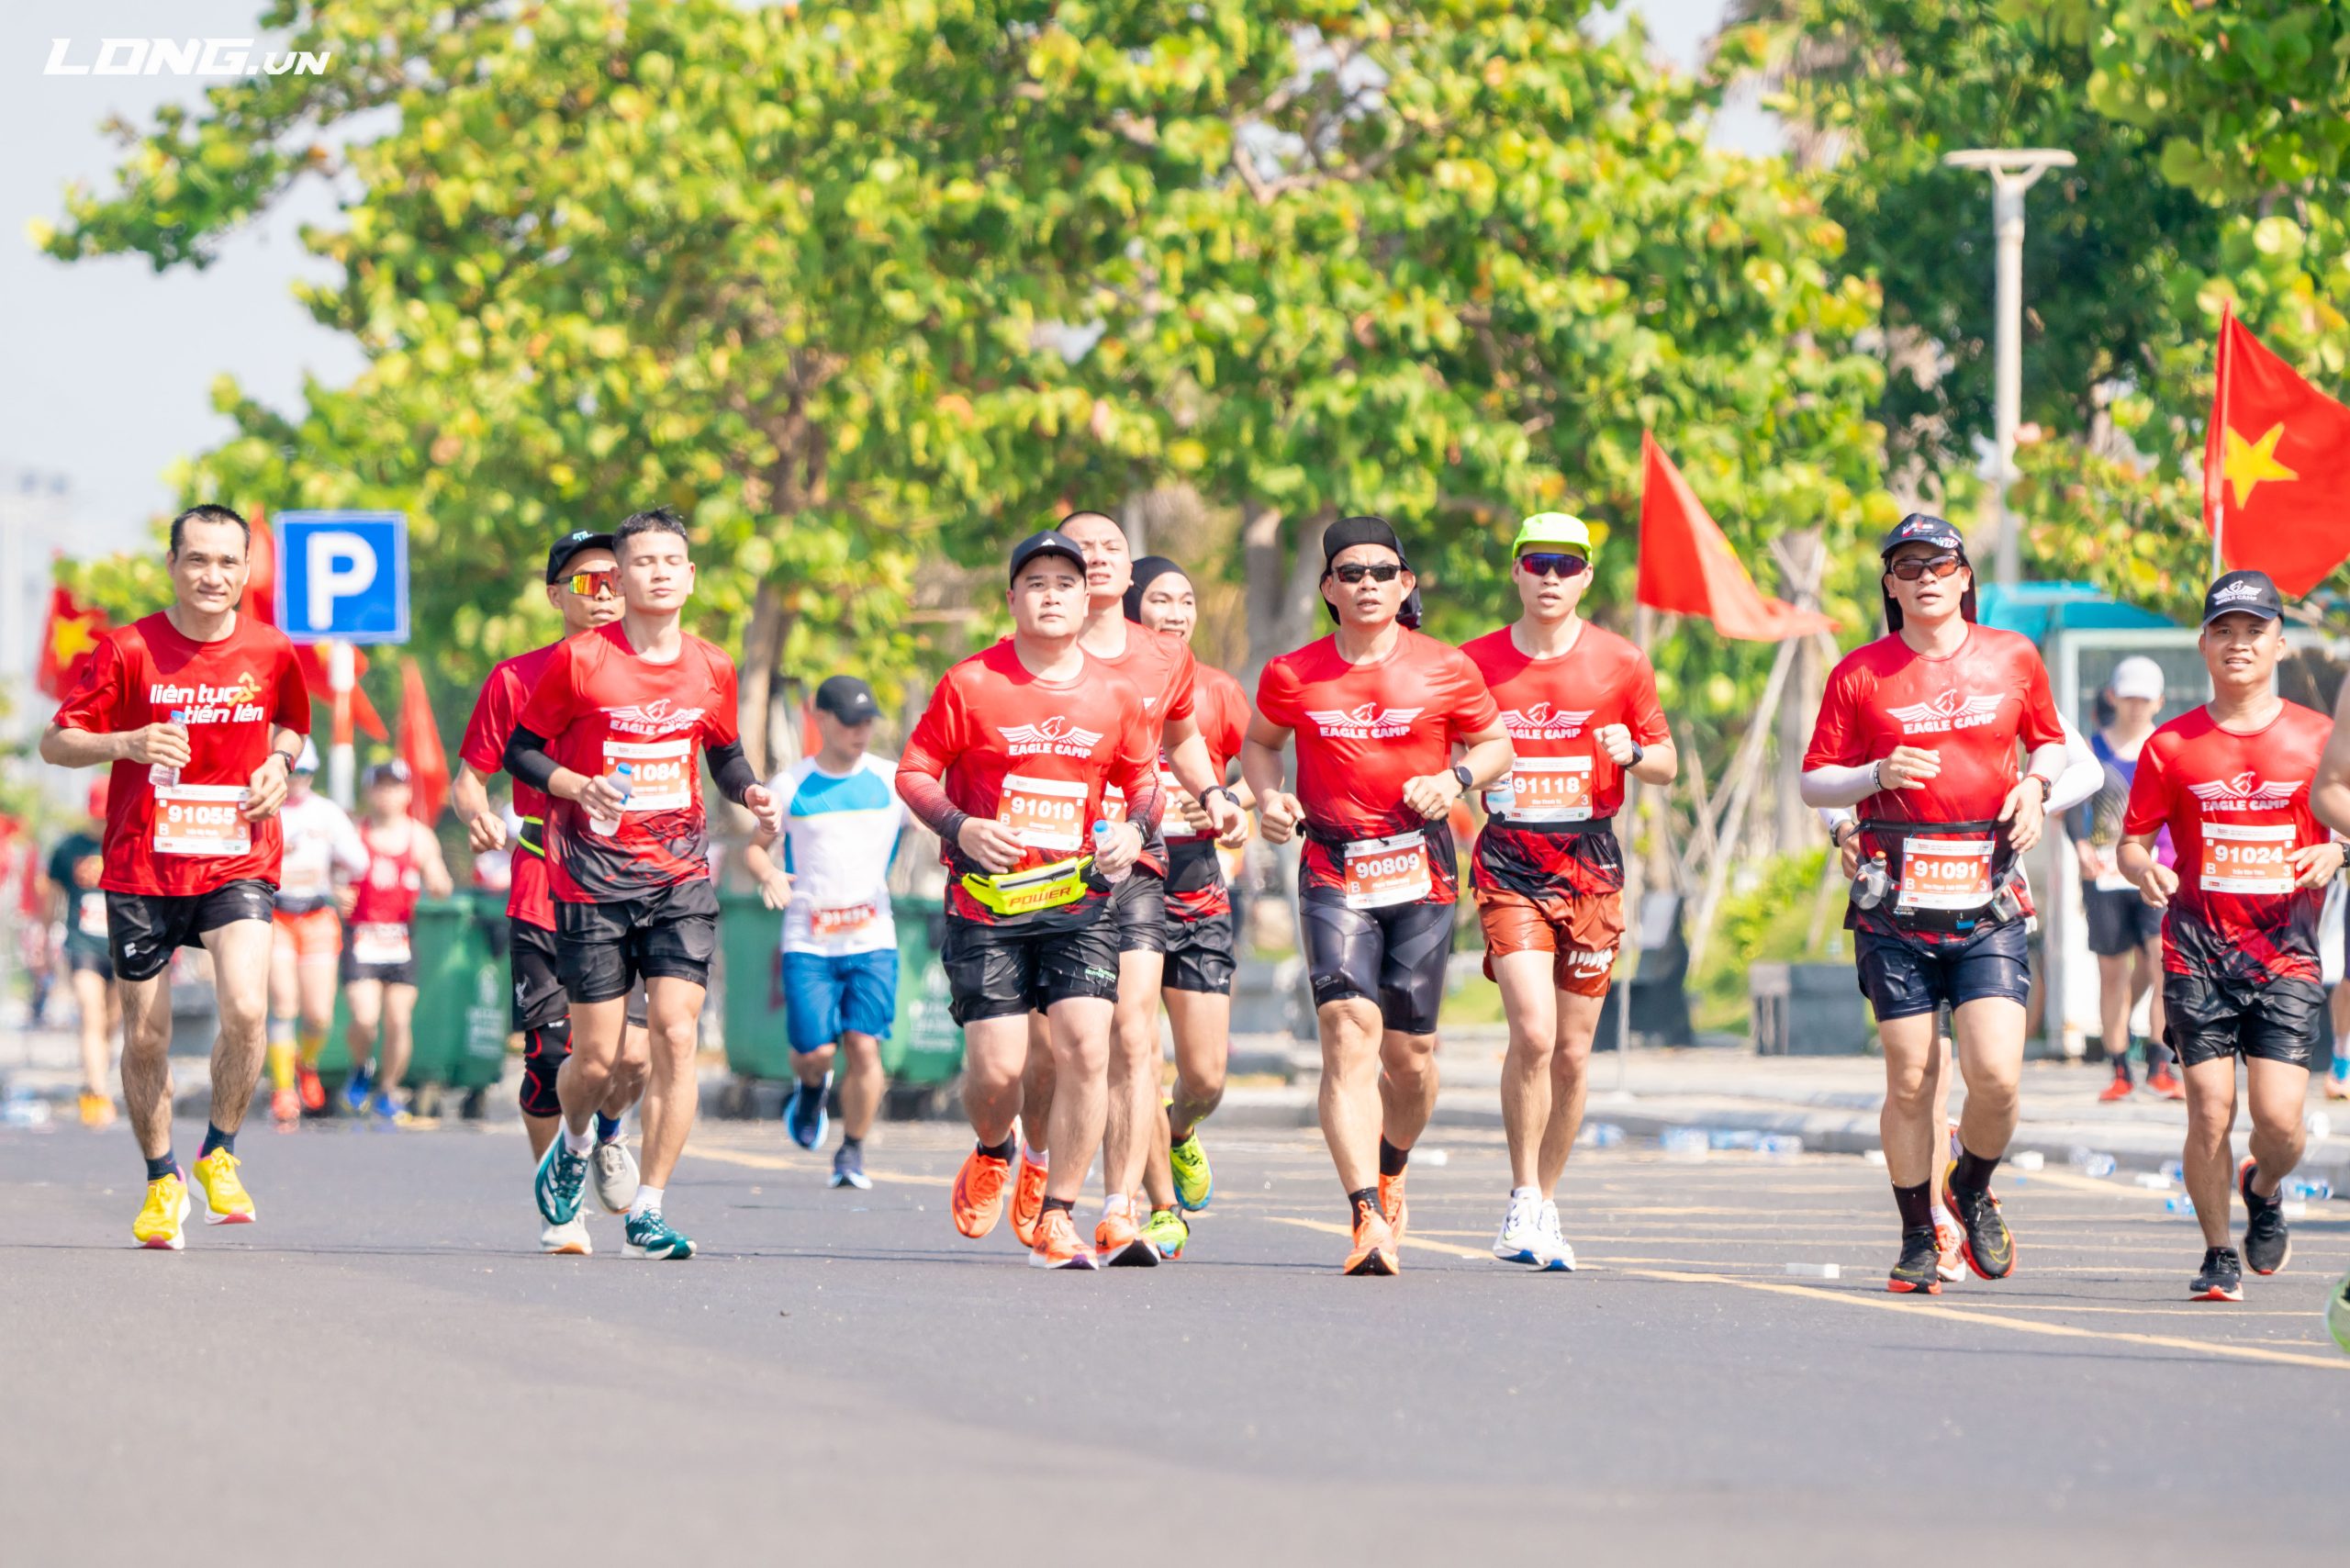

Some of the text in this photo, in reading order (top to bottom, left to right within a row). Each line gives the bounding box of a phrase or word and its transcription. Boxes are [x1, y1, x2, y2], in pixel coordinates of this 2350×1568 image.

[307, 531, 377, 630] P
[150, 684, 195, 704] liên
[232, 703, 264, 722] lên
[610, 719, 655, 735] EAGLE
[1903, 712, 1997, 735] EAGLE CAMP
[1319, 725, 1411, 739] EAGLE CAMP
[1508, 728, 1582, 740] AGLE CAMP
[1008, 743, 1092, 758] EAGLE CAMP
[630, 761, 681, 782] 1084
[1513, 776, 1581, 794] 91118
[1581, 794, 1589, 806] 3
[2201, 799, 2290, 812] EAGLE CAMP
[167, 804, 238, 825] 91055
[1010, 796, 1075, 821] 91019
[158, 823, 169, 835] B
[237, 826, 247, 839] 3
[2214, 845, 2284, 865] 91024
[1354, 852, 1420, 879] 90809
[1914, 859, 1979, 879] 91091
[2205, 862, 2216, 875] B
[2283, 864, 2291, 877] 3
[1350, 880, 1361, 894] B
[1905, 878, 1915, 890] B
[1978, 879, 1988, 892] 3
[1009, 886, 1072, 907] POWER
